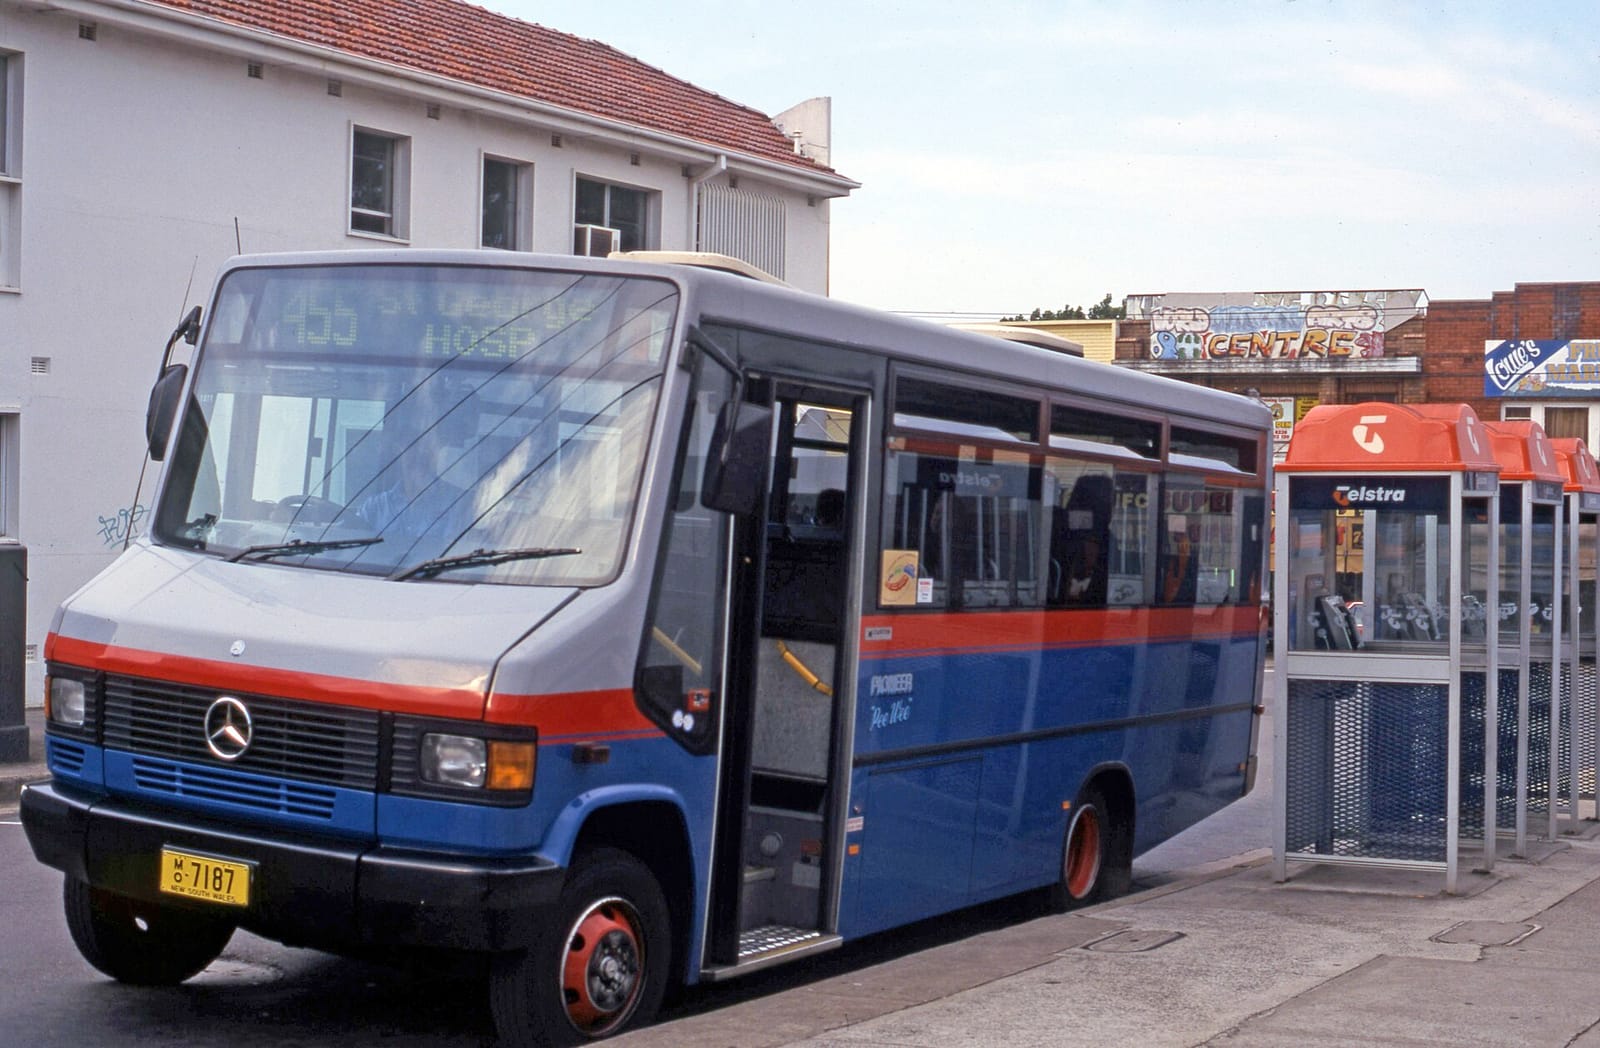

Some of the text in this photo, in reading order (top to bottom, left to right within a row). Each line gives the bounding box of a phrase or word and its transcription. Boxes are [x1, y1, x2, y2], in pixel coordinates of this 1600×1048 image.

[425, 324, 537, 357] HOSP
[1207, 329, 1356, 358] CENTRE
[1567, 341, 1600, 362] FR
[1545, 362, 1600, 383] MAR
[1333, 486, 1406, 506] Telstra
[870, 673, 913, 696] PIONEER
[188, 887, 211, 897] SOUTH
